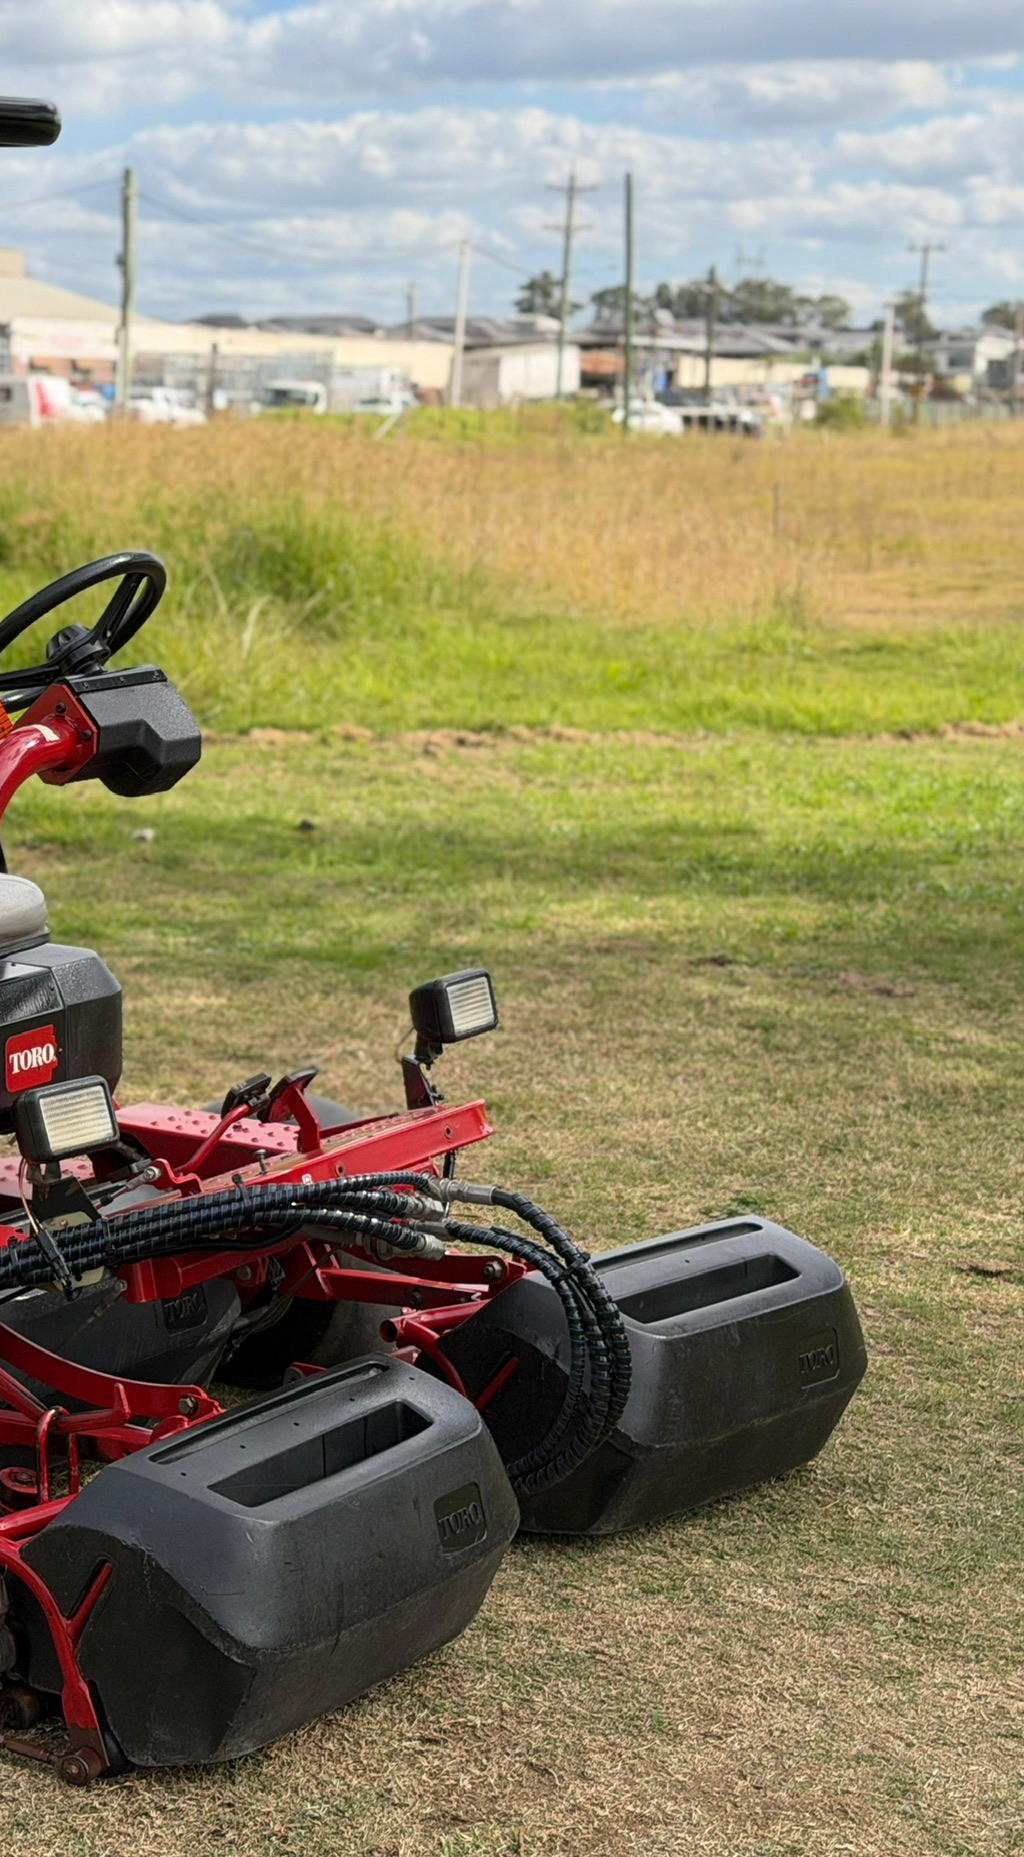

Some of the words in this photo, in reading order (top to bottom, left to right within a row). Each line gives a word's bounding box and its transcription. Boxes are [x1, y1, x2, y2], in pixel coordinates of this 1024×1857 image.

[9, 1043, 55, 1075] TORO
[798, 1344, 834, 1374] TORO
[438, 1502, 479, 1540] TORO
